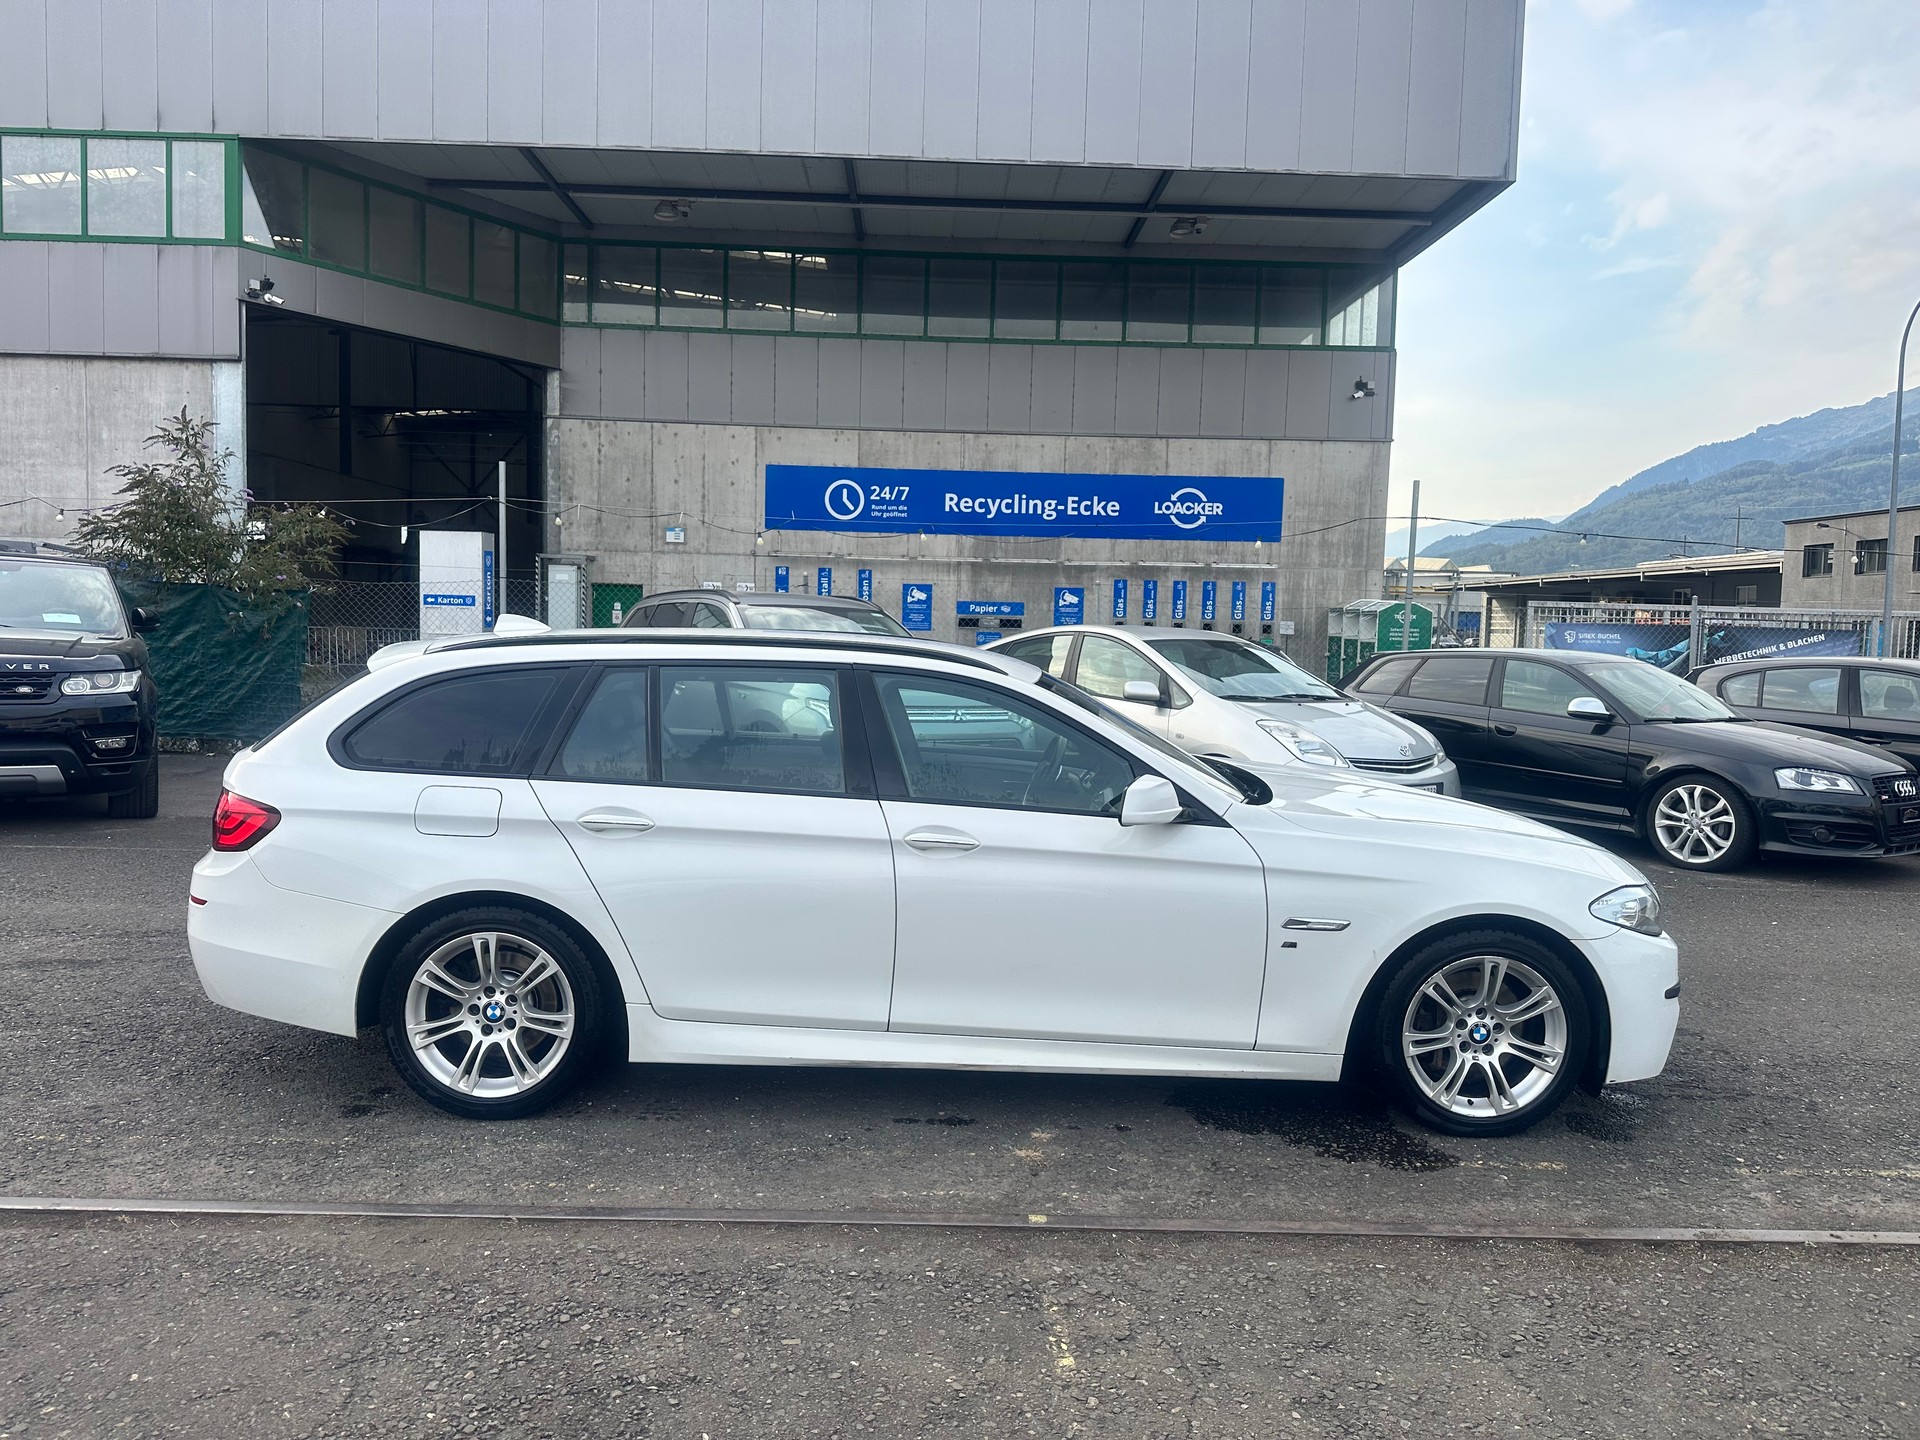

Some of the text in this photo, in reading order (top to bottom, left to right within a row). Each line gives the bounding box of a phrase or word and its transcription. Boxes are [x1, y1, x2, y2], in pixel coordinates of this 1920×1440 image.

[869, 485, 910, 500] 24/7
[944, 492, 1120, 520] Recycling-Ecke
[1154, 501, 1223, 515] LOACKER
[437, 596, 464, 604] Karton
[969, 604, 998, 614] Papier
[1115, 598, 1124, 618] Glas
[1145, 599, 1154, 618] Glas
[1175, 600, 1183, 619] Glas
[1204, 601, 1213, 620] Glas
[1234, 601, 1243, 620] Glas
[1263, 601, 1272, 620] Glas
[1713, 644, 1778, 664] WERBETECHNIK
[1779, 643, 1786, 651] &
[1787, 634, 1826, 649] BLACHEN
